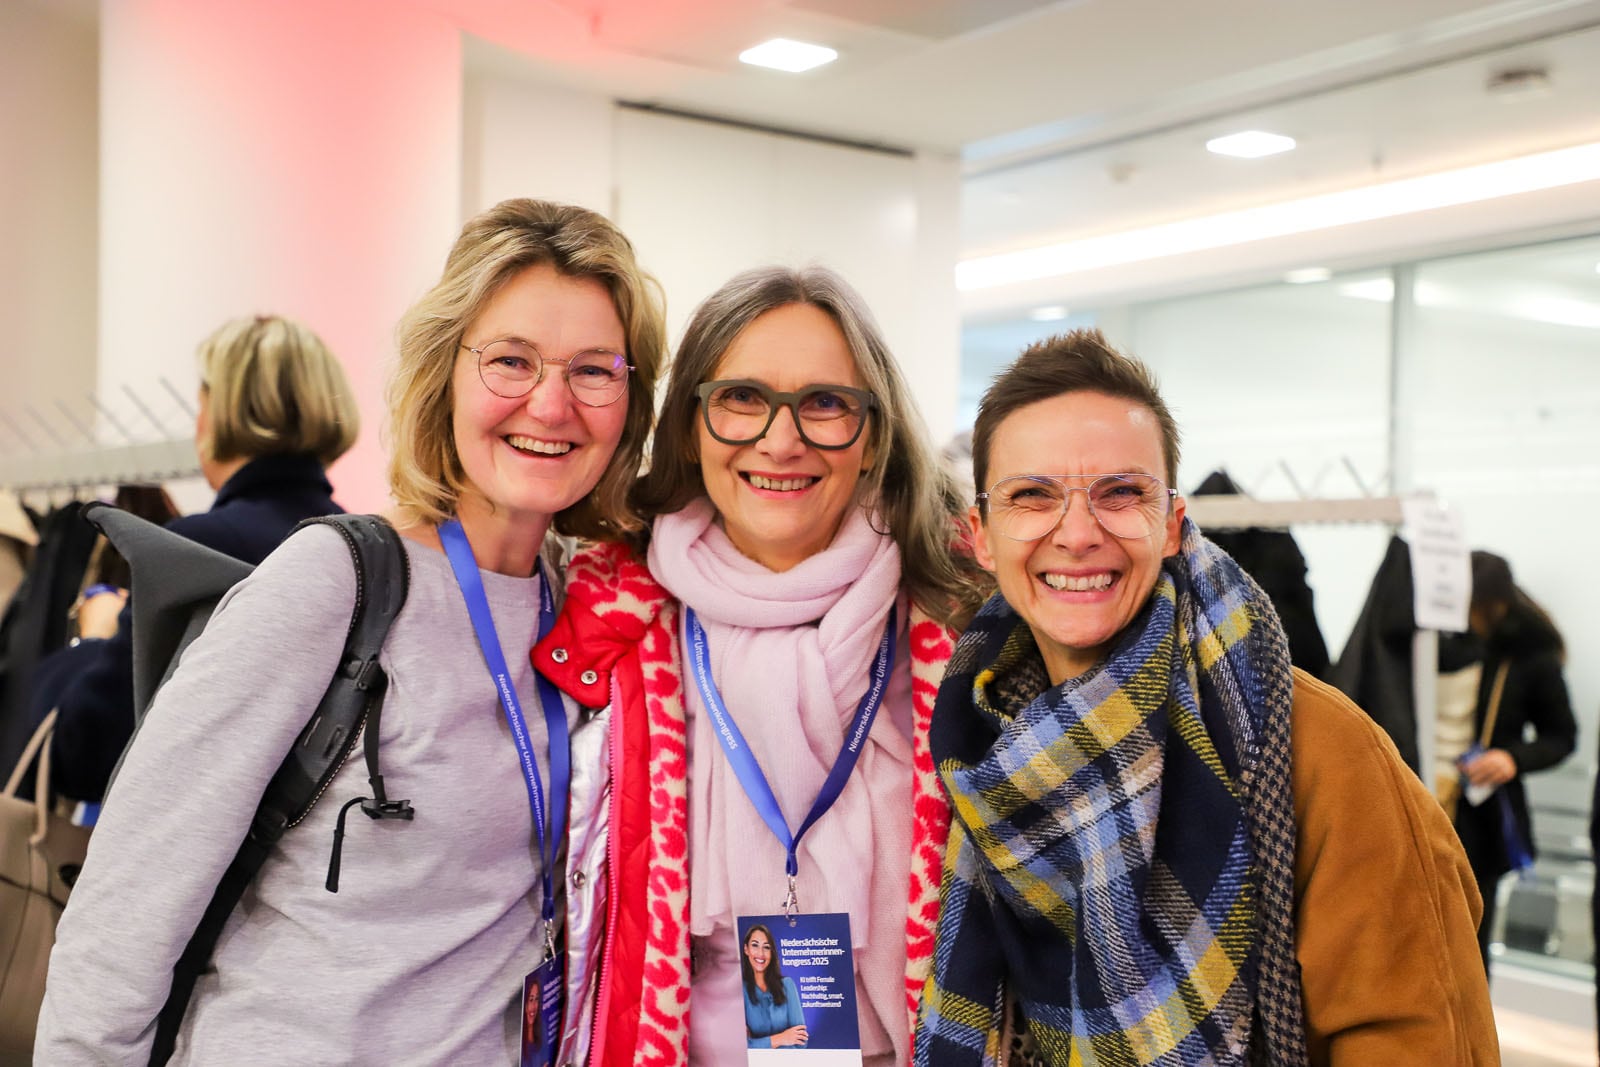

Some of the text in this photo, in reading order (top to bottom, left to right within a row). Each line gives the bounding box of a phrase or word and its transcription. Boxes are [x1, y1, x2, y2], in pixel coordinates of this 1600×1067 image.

[496, 673, 527, 751] Niedersächsischer
[694, 643, 739, 750] Unternehmerinnenkongress
[848, 677, 883, 753] Niedersächsischer
[781, 938, 838, 946] Niedersächsischer
[782, 948, 845, 956] Unternehmerinnen-
[782, 957, 829, 967] kongress 2025
